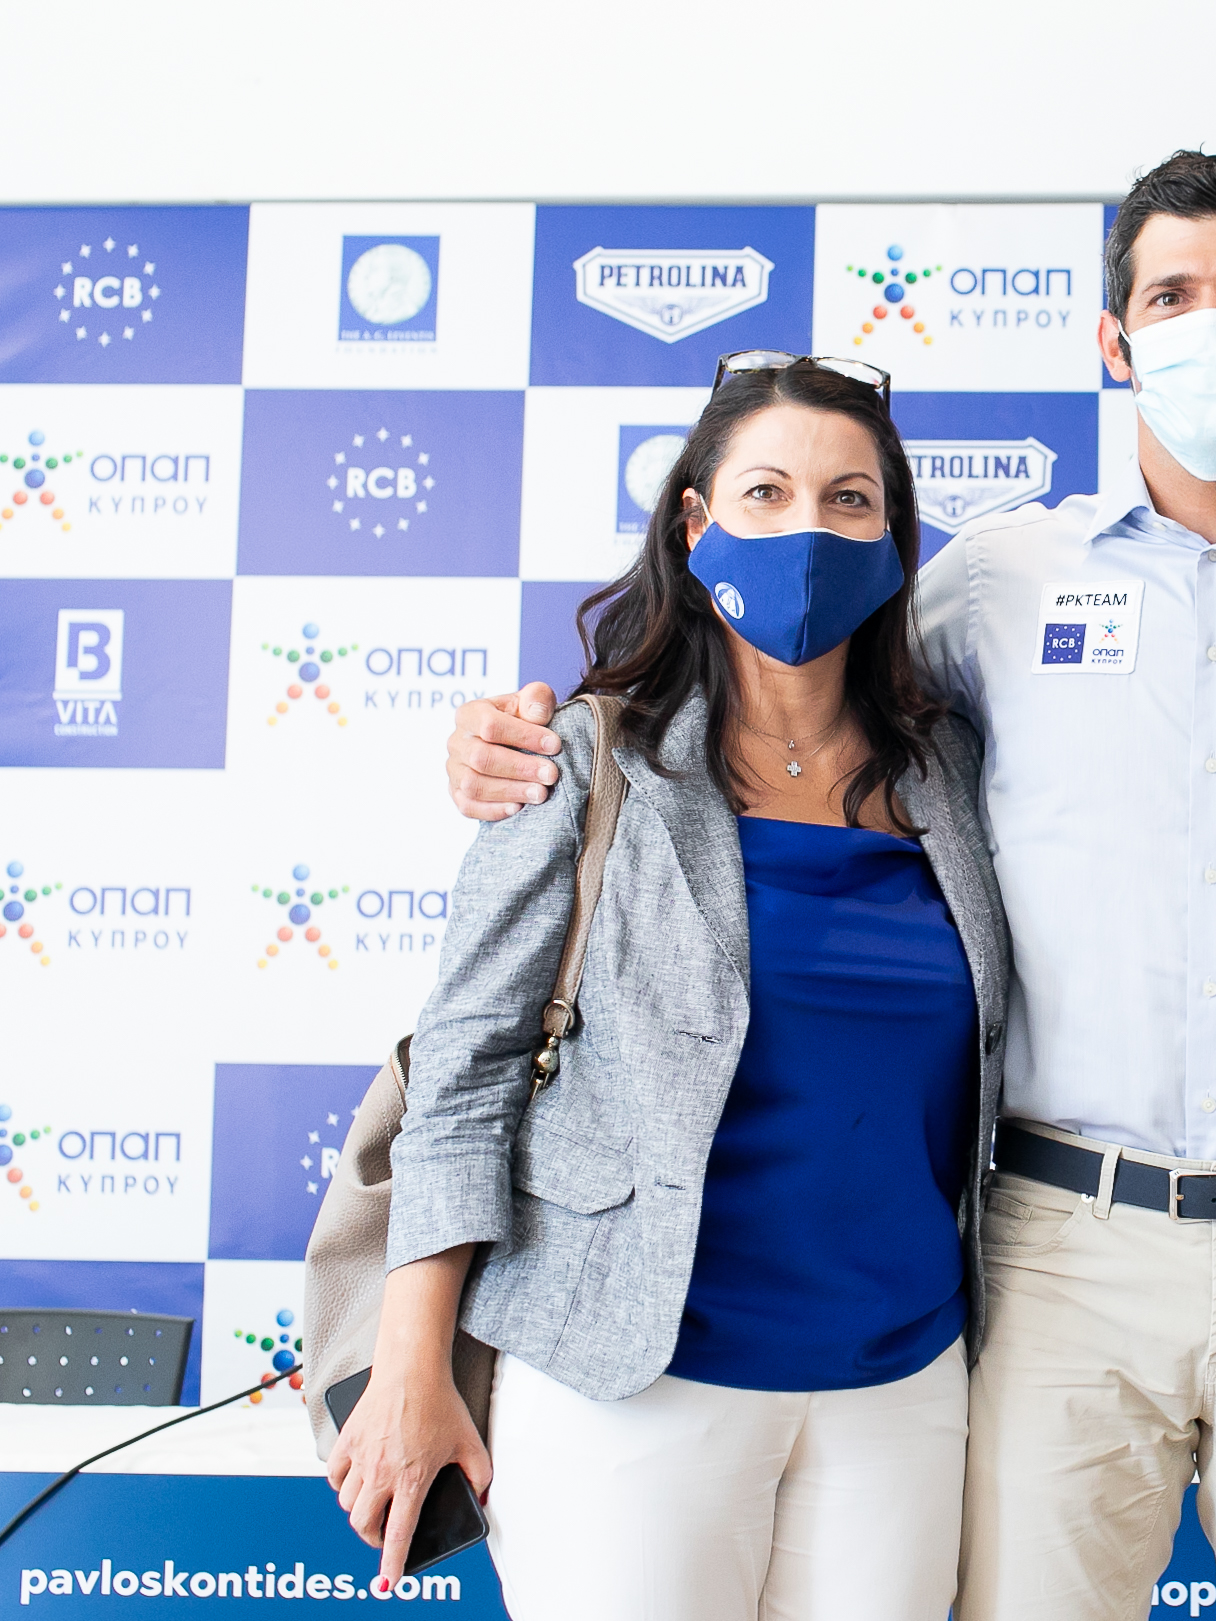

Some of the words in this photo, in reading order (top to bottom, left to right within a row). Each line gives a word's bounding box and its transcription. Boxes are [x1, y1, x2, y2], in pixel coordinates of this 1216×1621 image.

[599, 264, 746, 288] PETROLINA
[73, 276, 143, 308] RCB
[950, 309, 1070, 328] ΚΥΠΡΟΥ
[909, 455, 1030, 478] TROLINA
[346, 466, 417, 499] RCB
[89, 496, 207, 515] ΚΥΠΡΟΥ
[1056, 593, 1128, 606] #PKTEAM
[1052, 637, 1075, 648] RCB
[56, 700, 117, 724] VITA
[68, 930, 188, 950] ΚΥΠΡΟΥ
[356, 933, 435, 952] ΚΥΠΡ
[58, 1175, 178, 1195] ΚΥΠΡΟΥ
[20, 1559, 461, 1605] pavloskontides.com
